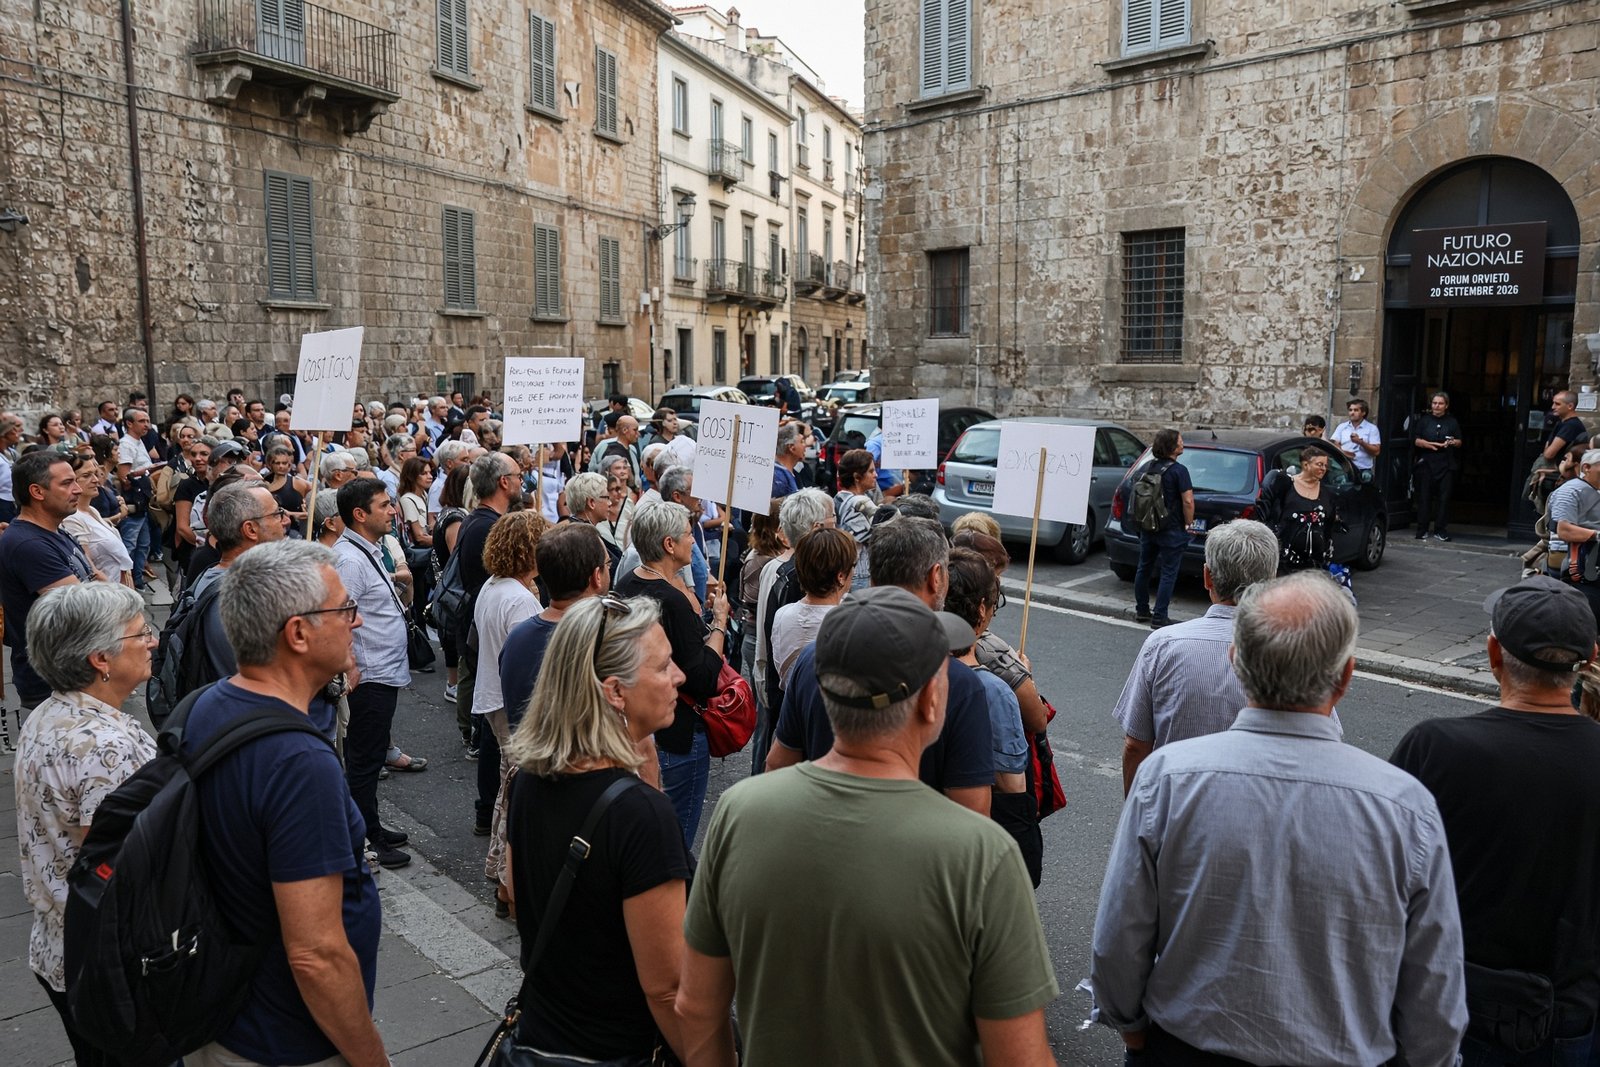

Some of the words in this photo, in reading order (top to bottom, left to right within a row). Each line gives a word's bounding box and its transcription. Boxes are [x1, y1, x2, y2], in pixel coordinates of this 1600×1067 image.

[1443, 233, 1512, 250] FUTURO
[1427, 250, 1524, 268] NAZIONALE
[1440, 274, 1469, 285] FORUM
[1472, 272, 1510, 284] ORVIETO
[1430, 287, 1441, 297] 20
[1443, 285, 1494, 297] SETTEMBRE
[1496, 285, 1519, 295] 2026
